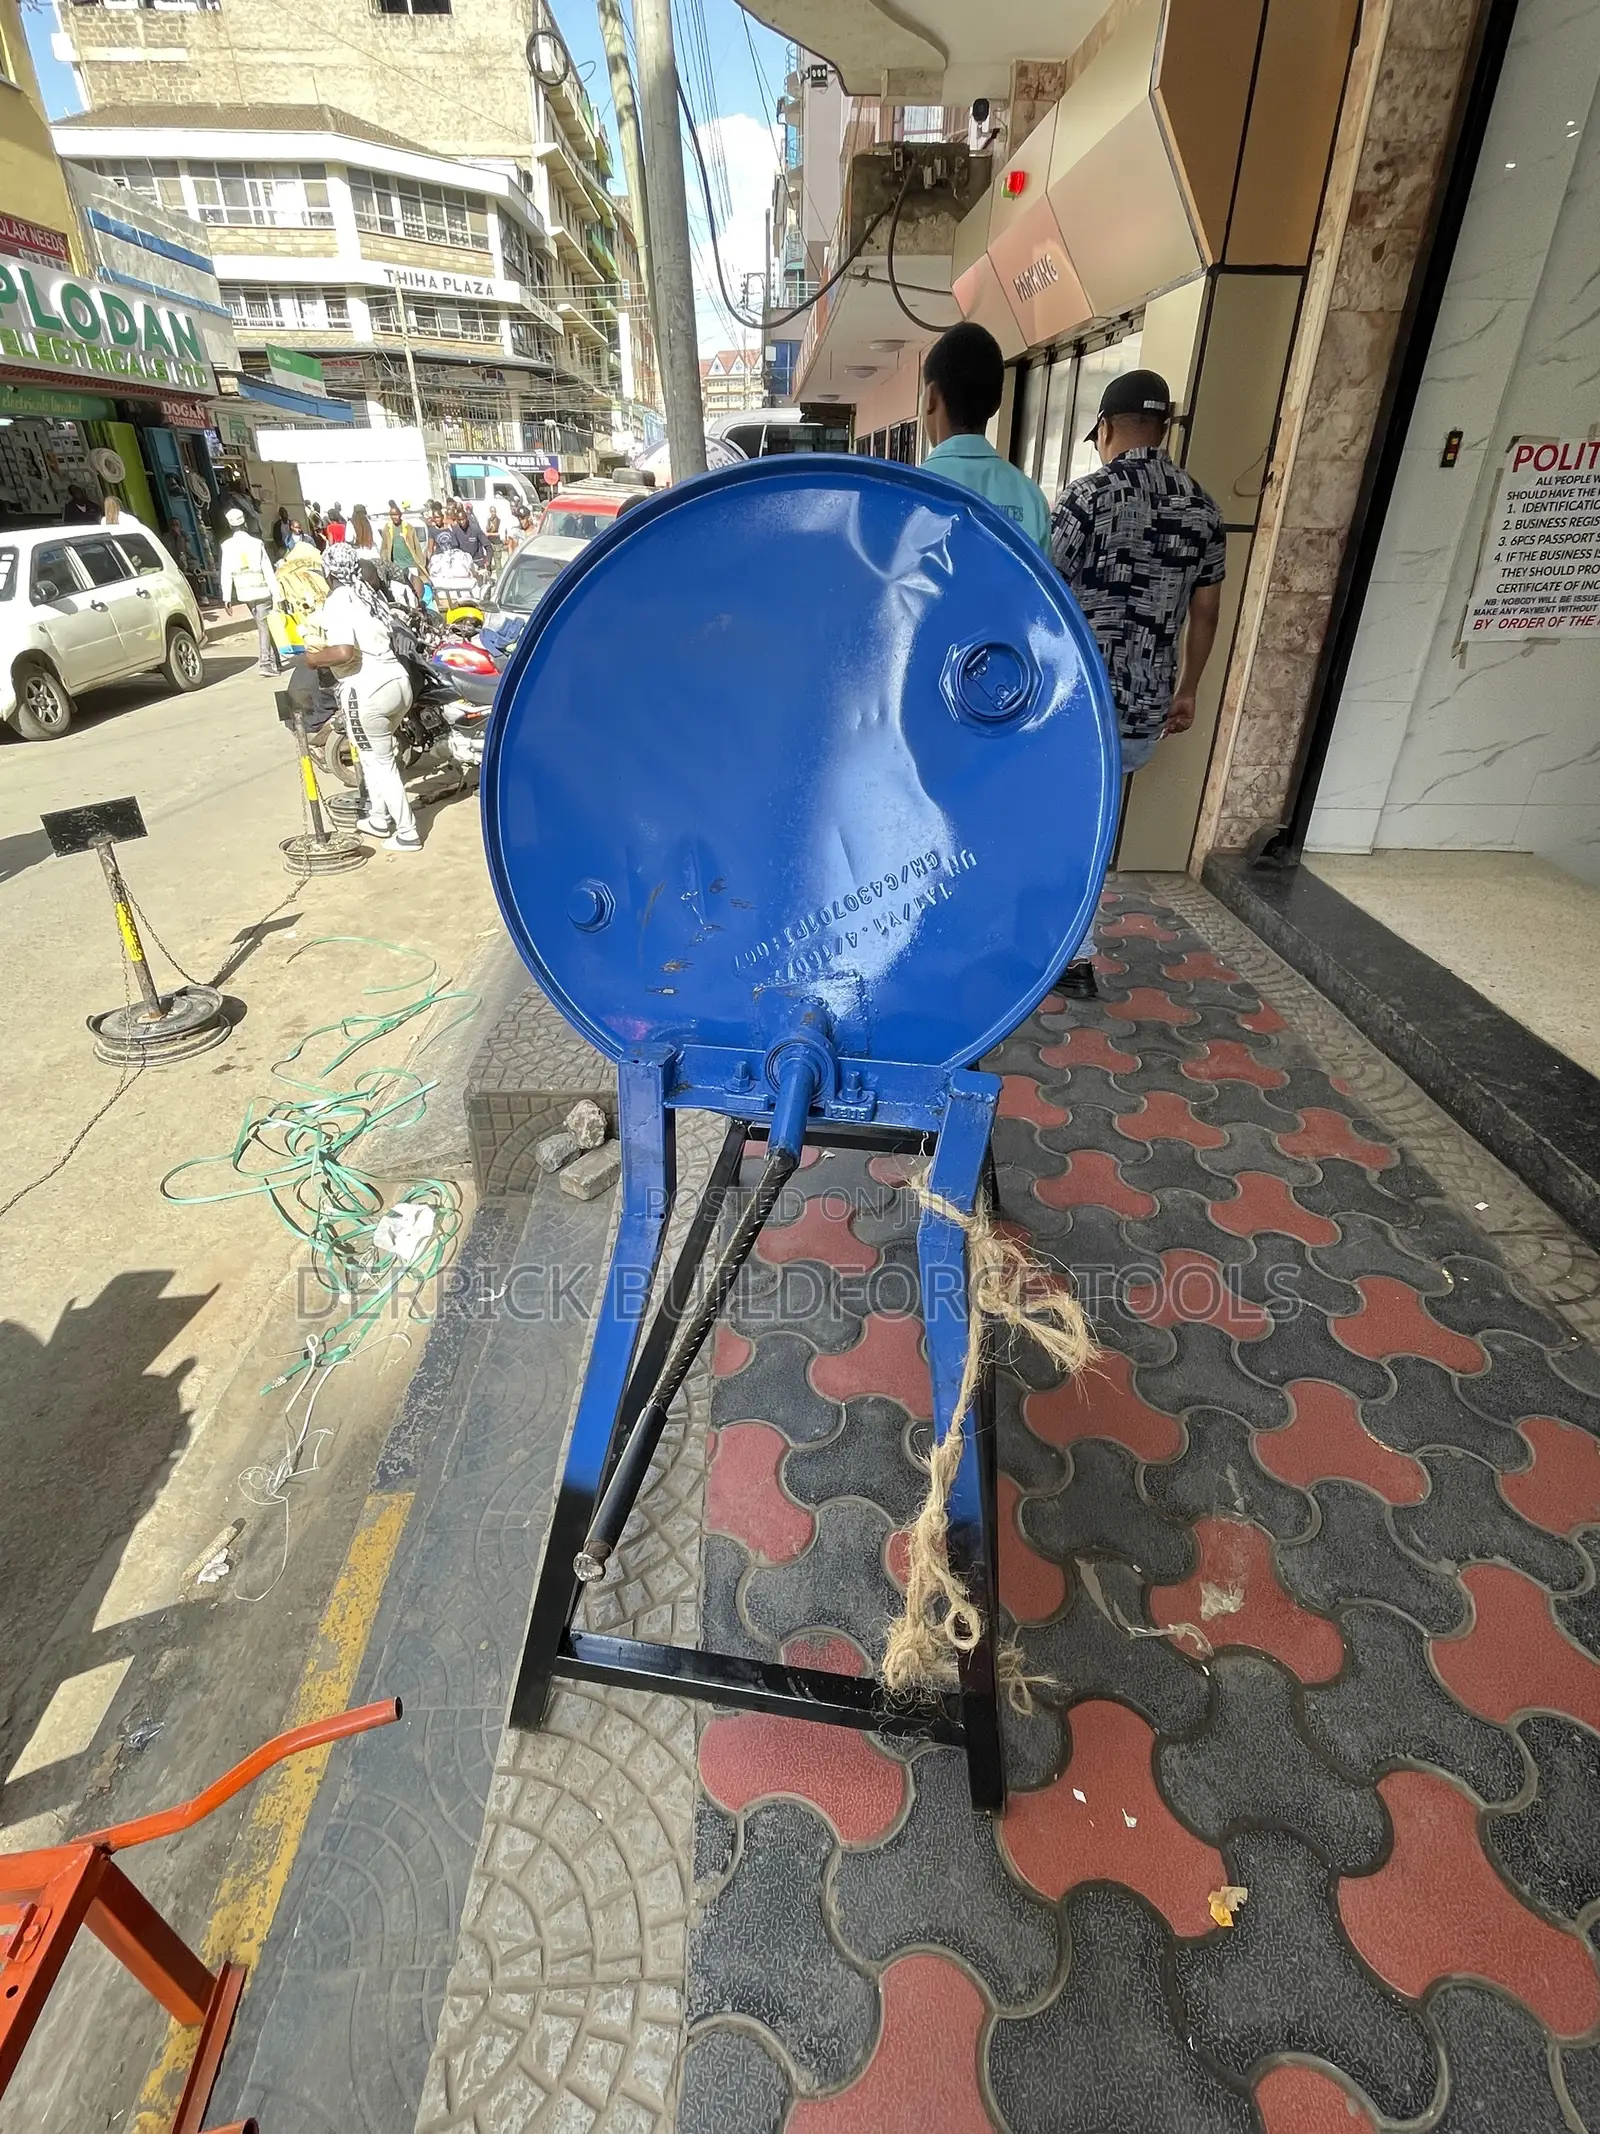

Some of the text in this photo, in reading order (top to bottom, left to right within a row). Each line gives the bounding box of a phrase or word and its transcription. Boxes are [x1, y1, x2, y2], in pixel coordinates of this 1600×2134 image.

[28, 226, 66, 254] NEEDS
[383, 269, 494, 297] THIHA PLAZA
[1013, 253, 1058, 303] PARKING
[162, 399, 206, 420] DOGAN
[1512, 442, 1600, 473] POLIT
[1535, 477, 1552, 486] ALL
[1554, 475, 1592, 485] PEOPLE
[1507, 488, 1597, 500] SHOULD HAVE THE
[1507, 503, 1516, 514] 1.
[1515, 517, 1568, 529] BUSINESS
[1498, 536, 1507, 546] 3.
[1510, 535, 1536, 546] 6PCS
[1537, 533, 1595, 545] PASSPORT
[1494, 552, 1502, 562] 4.
[1506, 552, 1517, 562] IF
[1519, 551, 1538, 561] THE
[1539, 549, 1592, 560] BUSINESS
[1501, 567, 1528, 578] THEY
[1529, 565, 1575, 577] SHOULD
[1496, 581, 1562, 593] CERTIFICATE
[1563, 581, 1580, 591] OF
[1501, 597, 1538, 605] NOBODY
[1538, 596, 1557, 604] WILL
[1559, 595, 1573, 603] BE
[1473, 605, 1598, 616] MAKE ANY PAYMENT WITHOUT
[1473, 615, 1597, 630] BY ORDER OF THE
